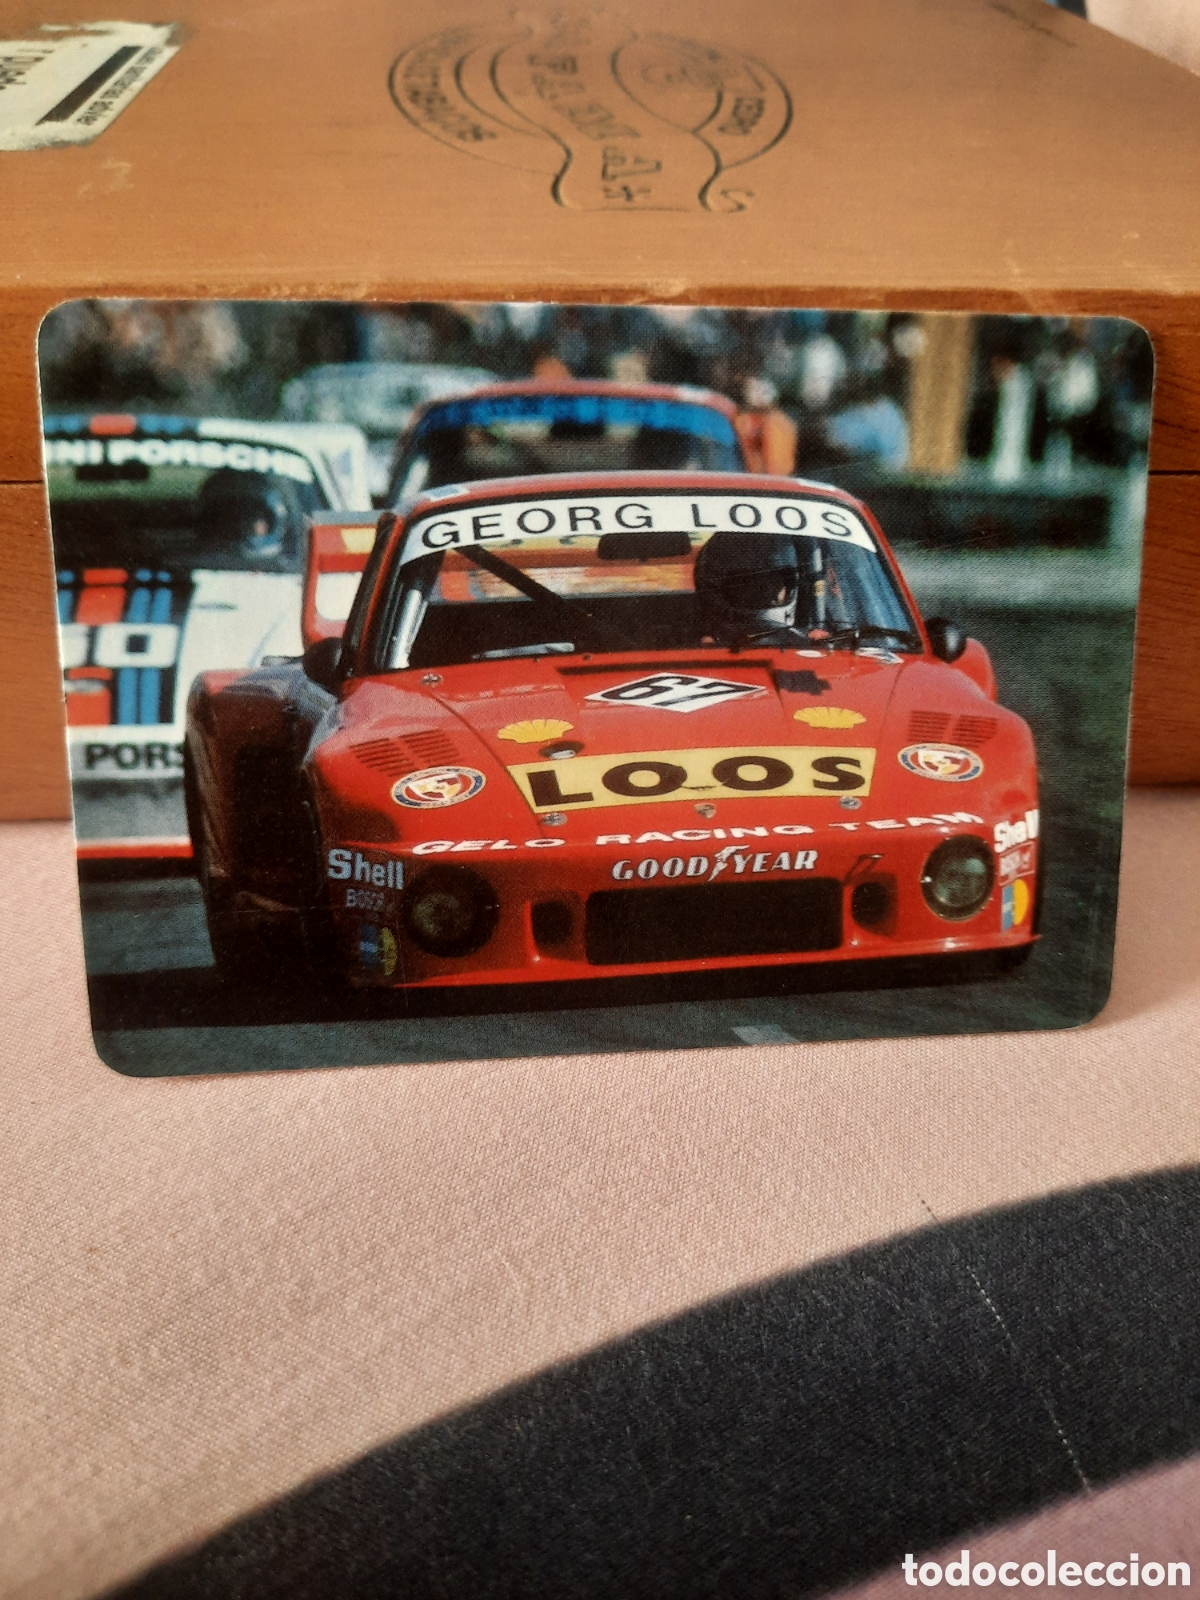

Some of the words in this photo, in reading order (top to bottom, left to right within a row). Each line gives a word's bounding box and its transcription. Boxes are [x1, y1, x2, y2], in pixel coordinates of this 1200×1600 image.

[107, 437, 314, 484] PORSCHE
[421, 502, 654, 549] GEORG
[691, 502, 853, 538] LOOS
[600, 675, 760, 707] 67
[527, 755, 866, 807] LOOS
[412, 837, 566, 855] GELO
[596, 823, 815, 845] RACING
[828, 811, 984, 831] TEAM
[327, 848, 405, 891] Shell
